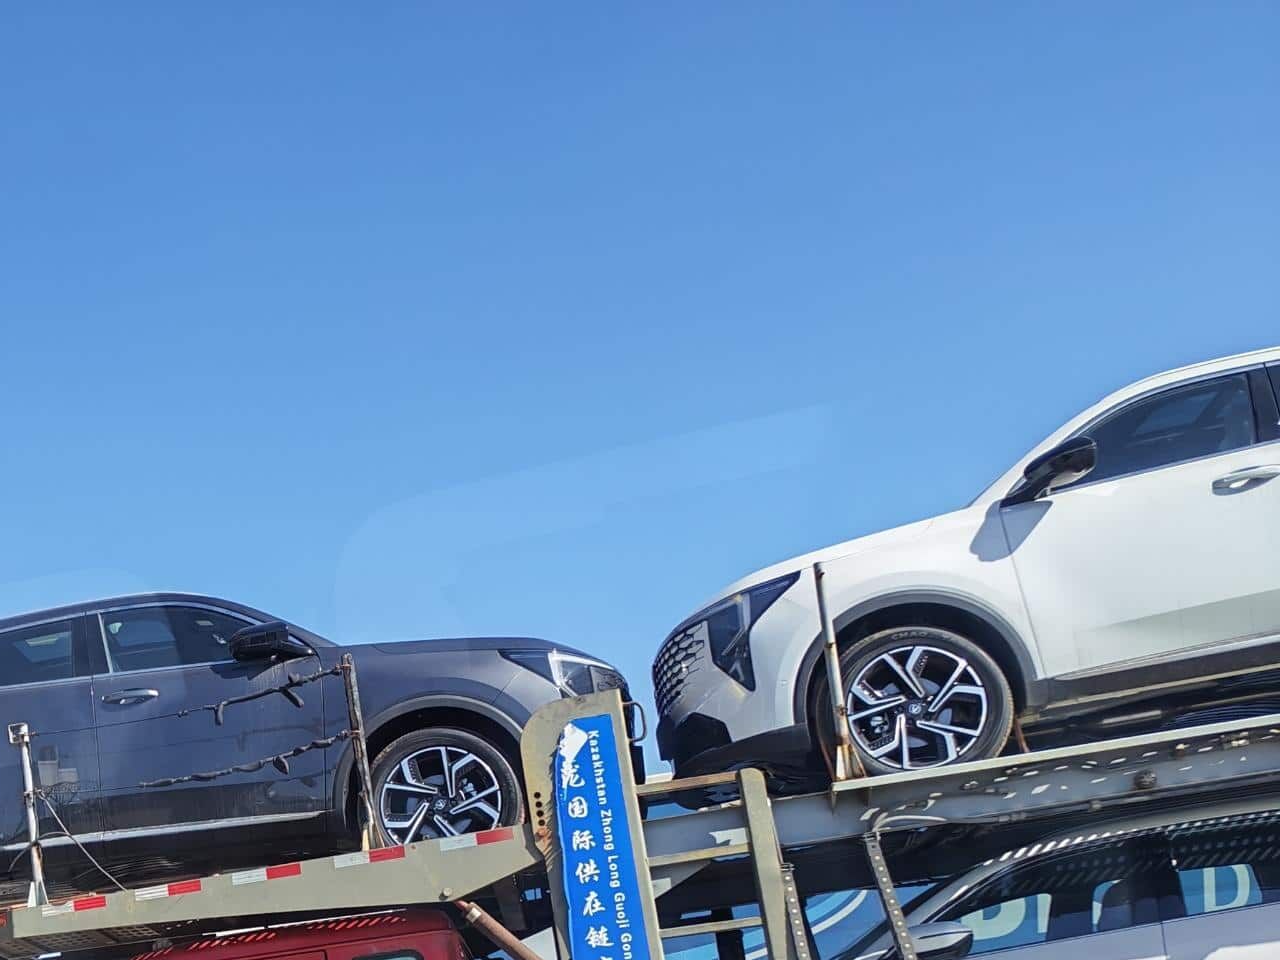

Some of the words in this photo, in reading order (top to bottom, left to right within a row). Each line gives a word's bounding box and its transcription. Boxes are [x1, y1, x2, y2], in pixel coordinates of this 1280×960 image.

[588, 730, 607, 805] Kazakhstan
[600, 809, 615, 850] Zhong
[608, 855, 620, 888] Long
